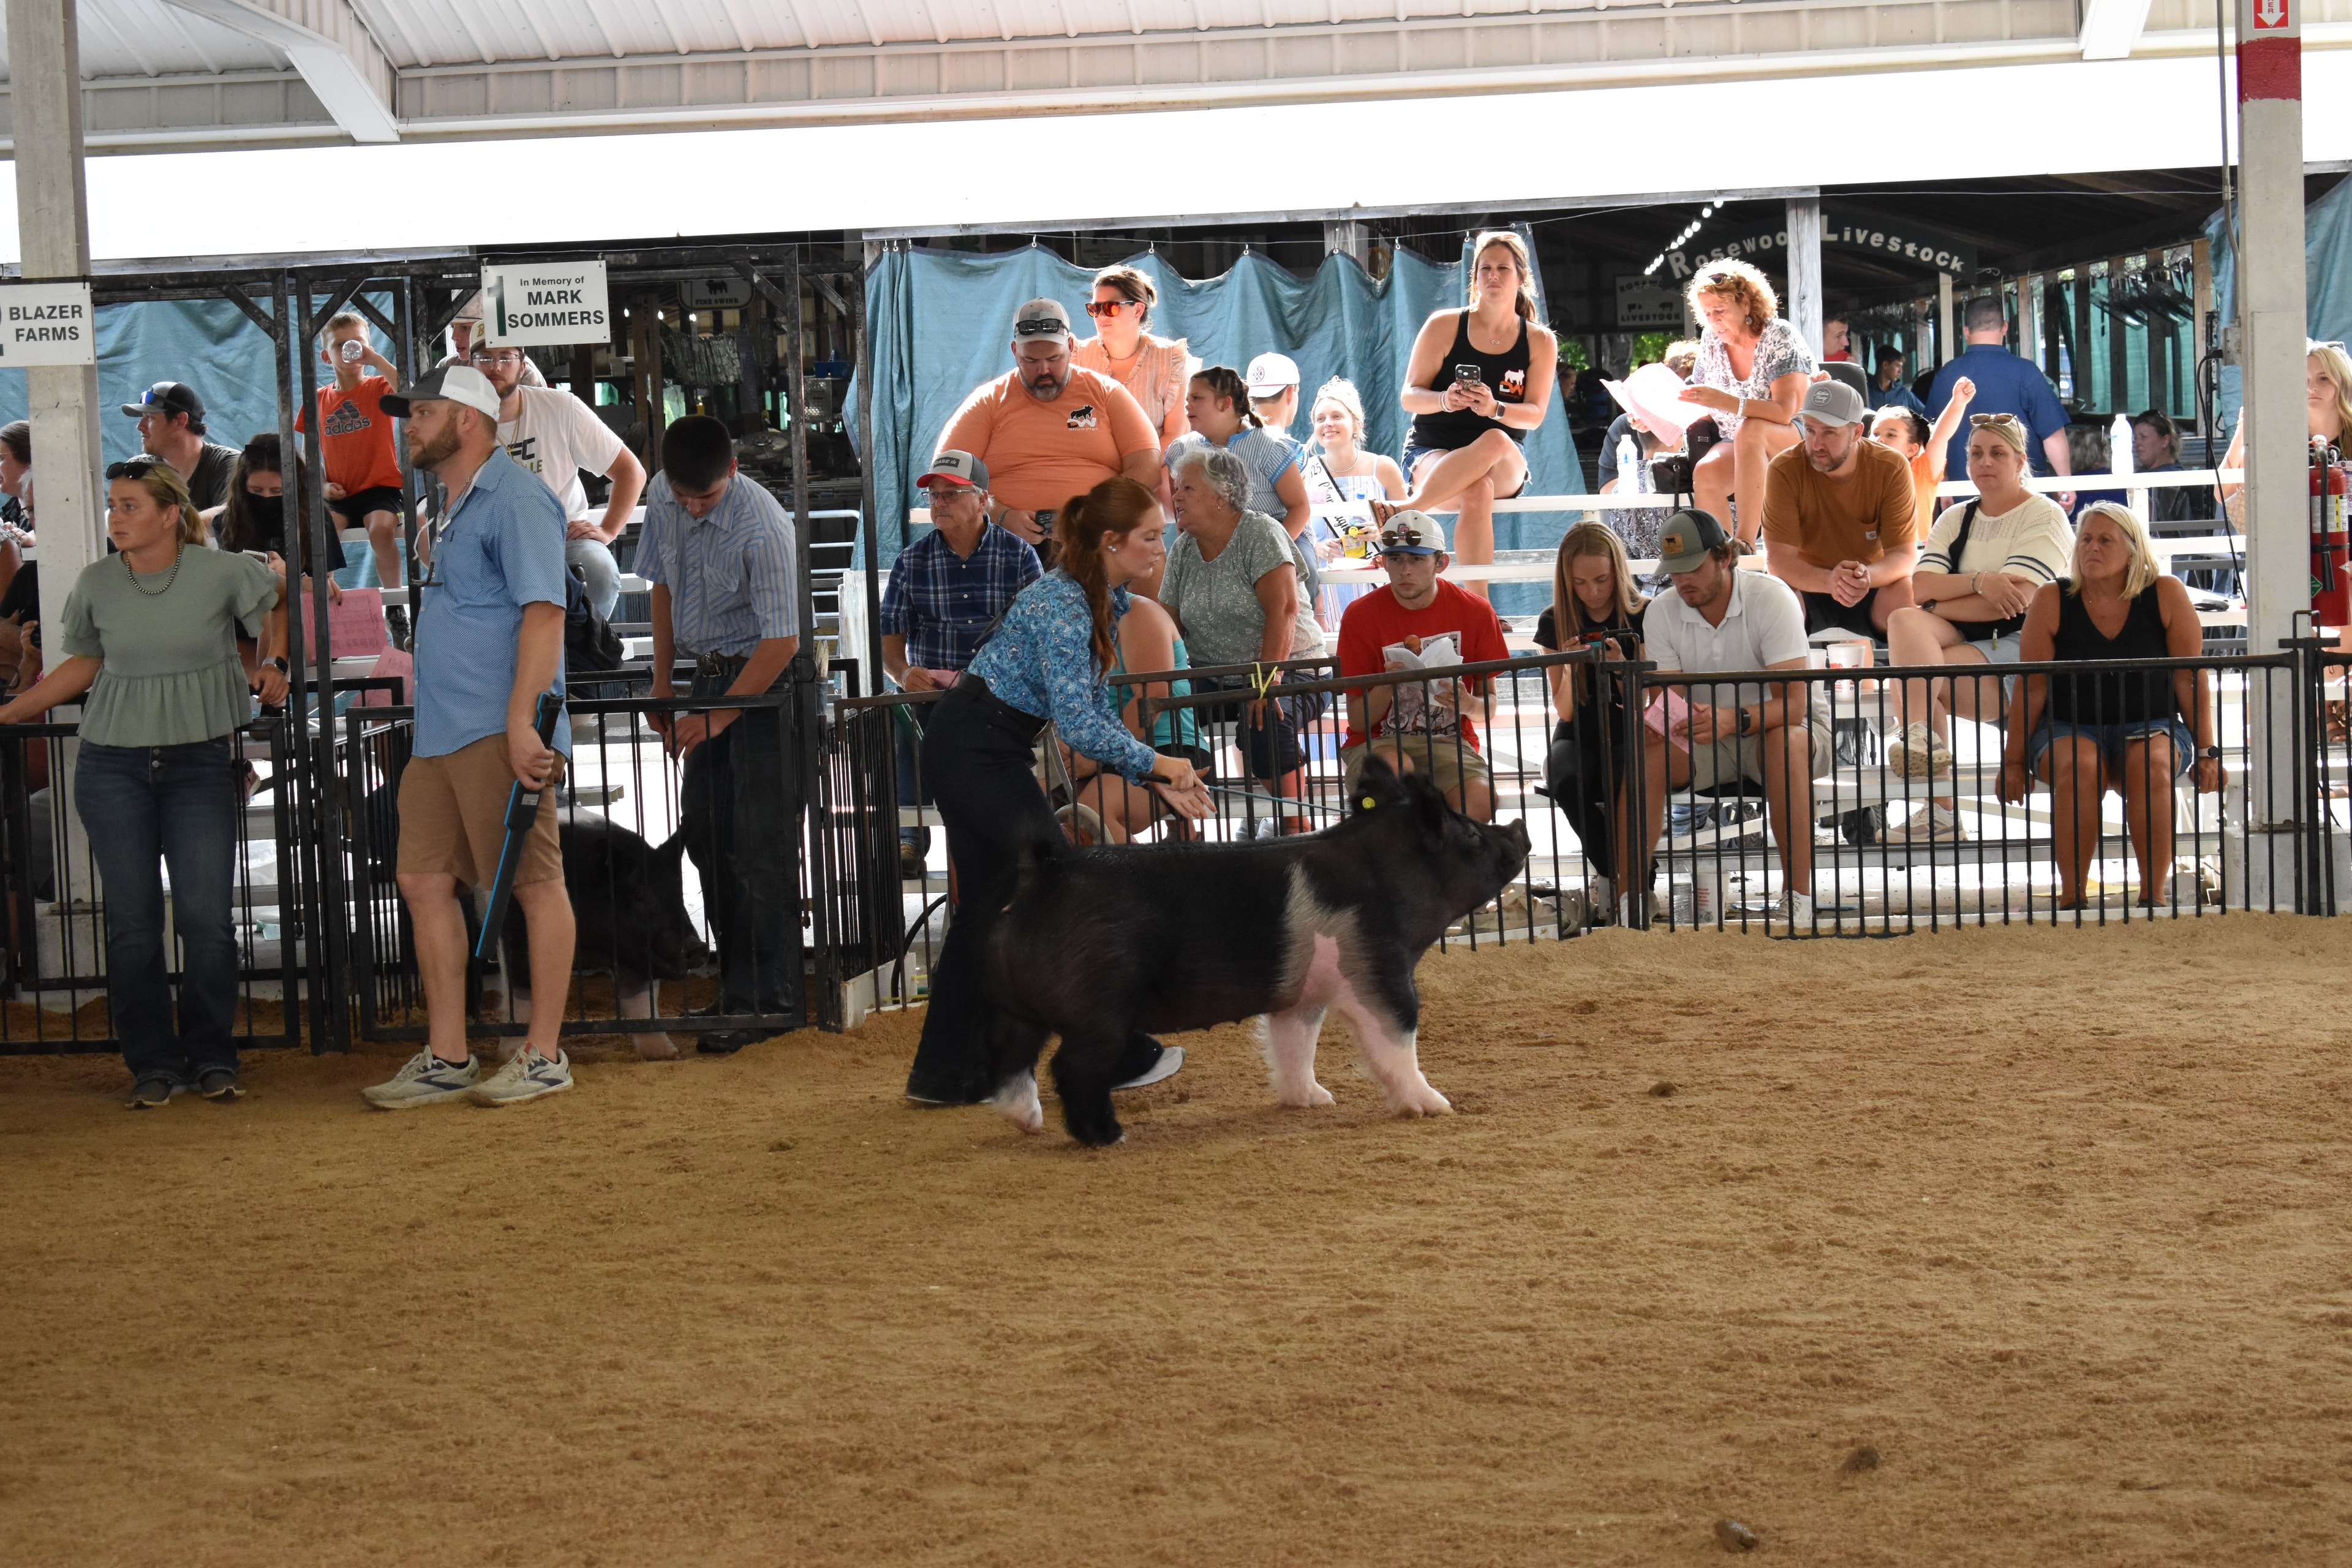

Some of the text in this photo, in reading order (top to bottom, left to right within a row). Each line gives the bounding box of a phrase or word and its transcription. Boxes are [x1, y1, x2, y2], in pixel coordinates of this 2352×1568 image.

[1667, 215, 1964, 279] Rosewoo Livestock
[532, 277, 572, 287] Memory
[527, 289, 583, 306] MARK
[9, 304, 83, 321] BLAZER
[507, 310, 605, 329] SOMMERS
[15, 326, 80, 342] FARMS
[324, 417, 372, 436] adidas
